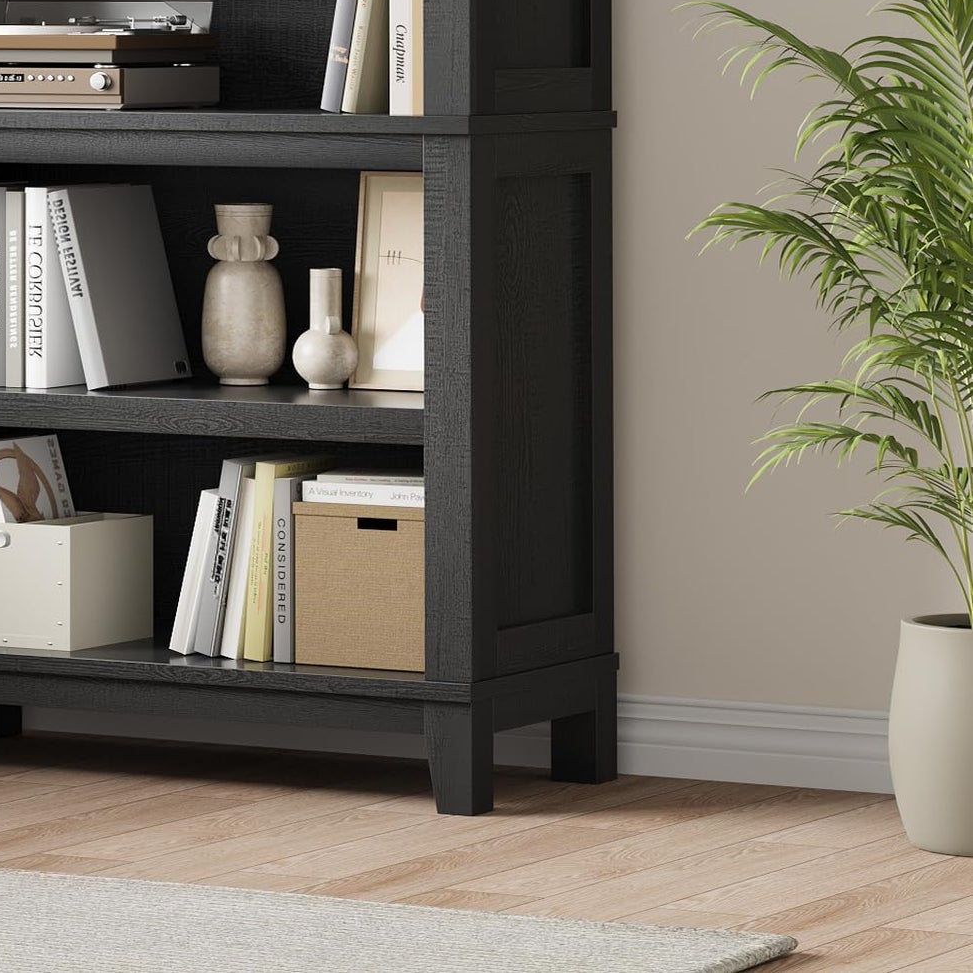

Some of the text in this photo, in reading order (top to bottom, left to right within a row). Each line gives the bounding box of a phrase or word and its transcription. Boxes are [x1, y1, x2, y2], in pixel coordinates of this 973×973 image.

[393, 23, 408, 84] Спартак
[308, 487, 374, 499] A Visual Inventory
[390, 491, 409, 501] John
[276, 517, 286, 624] CONSIDERED
